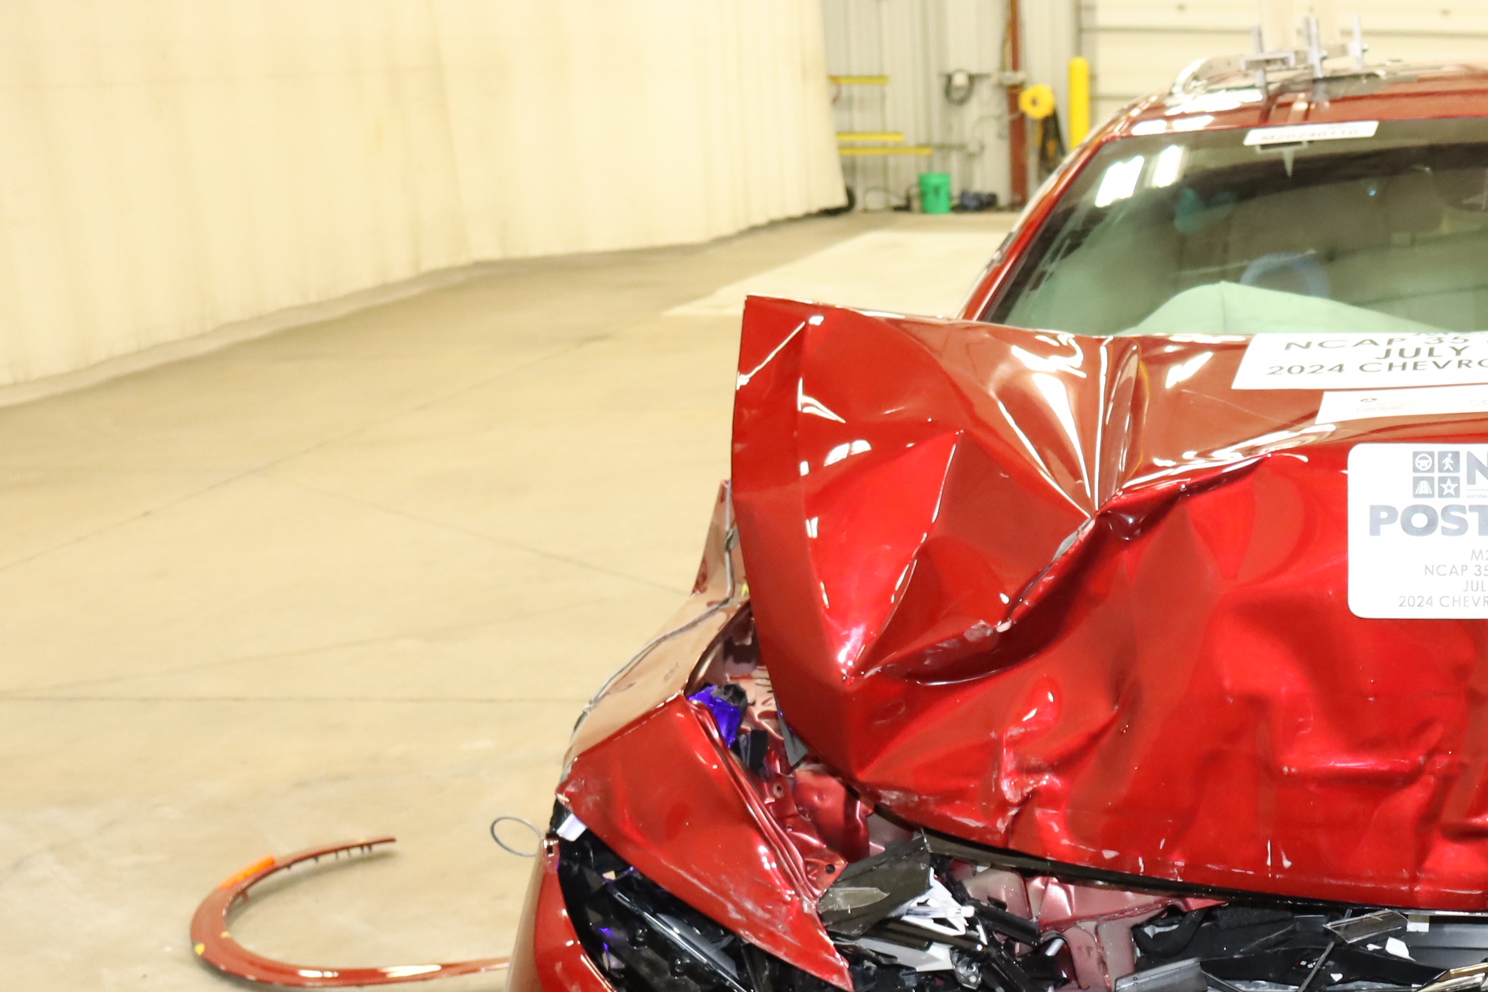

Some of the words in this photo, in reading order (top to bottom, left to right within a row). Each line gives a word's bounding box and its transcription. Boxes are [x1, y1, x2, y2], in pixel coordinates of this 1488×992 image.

[1284, 338, 1406, 350] NCAP
[1424, 336, 1470, 346] 35
[1375, 345, 1470, 360] JULY
[1267, 364, 1345, 375] 2024
[1424, 564, 1468, 577] NCAP
[1398, 596, 1434, 608] 2024
